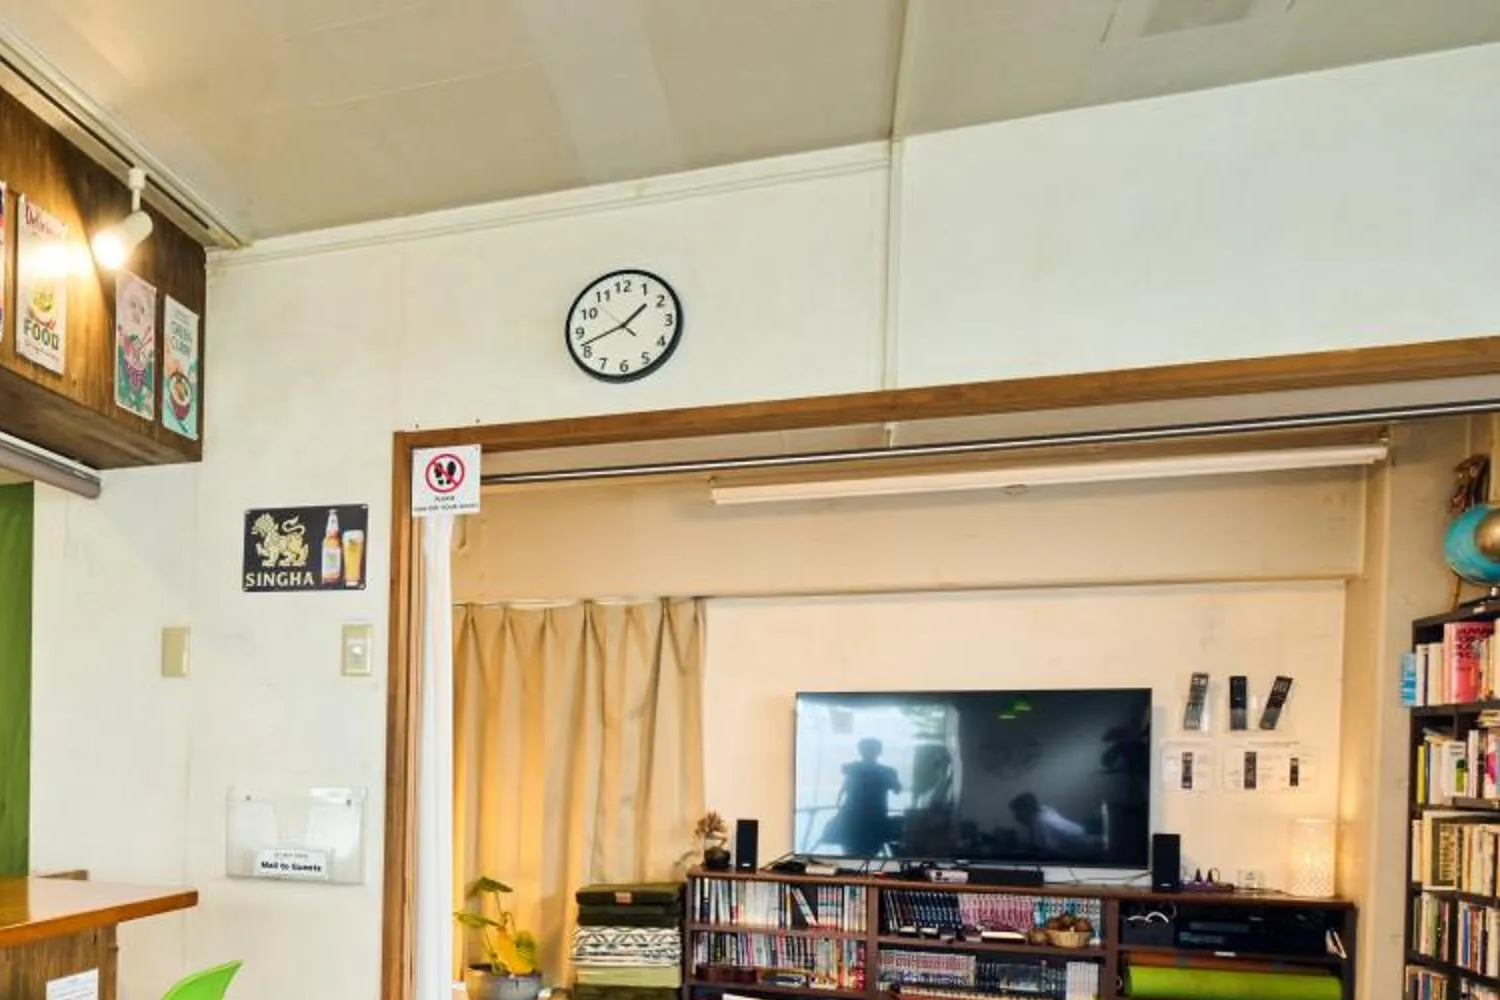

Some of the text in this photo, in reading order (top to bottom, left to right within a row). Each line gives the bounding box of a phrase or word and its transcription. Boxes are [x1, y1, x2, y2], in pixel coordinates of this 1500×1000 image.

[615, 280, 631, 294] 12
[641, 283, 647, 296] 1
[596, 290, 611, 302] 11
[656, 294, 665, 308] 2
[581, 307, 598, 320] 10
[664, 313, 673, 327] 3
[23, 318, 60, 350] FOOD
[575, 327, 585, 339] 9
[657, 335, 666, 347] 4
[583, 346, 592, 358] 8
[641, 352, 650, 365] 5
[599, 357, 608, 369] 7
[619, 360, 629, 372] 6
[244, 572, 315, 588] SINGHA
